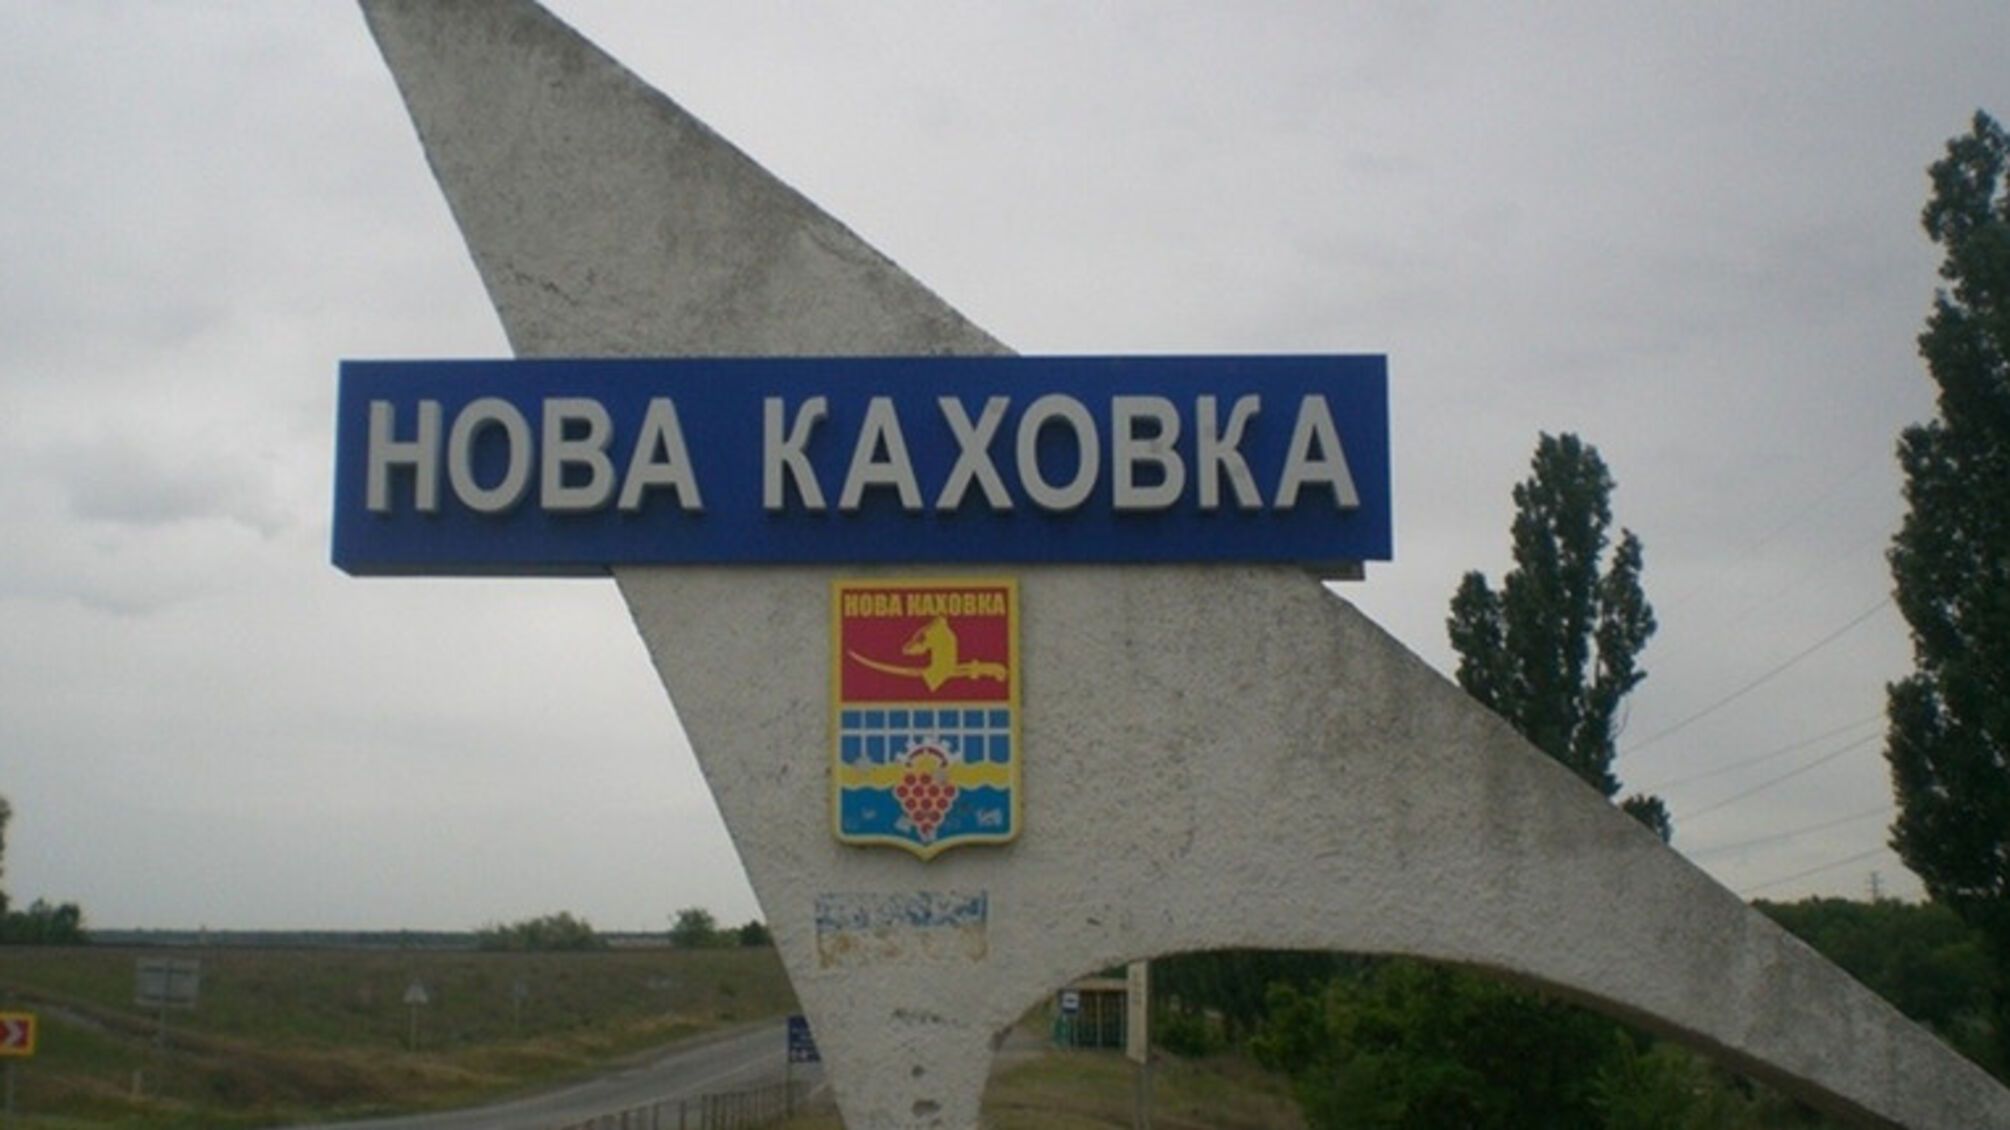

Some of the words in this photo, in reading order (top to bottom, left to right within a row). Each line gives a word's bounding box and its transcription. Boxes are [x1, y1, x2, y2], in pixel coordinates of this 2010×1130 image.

[366, 397, 702, 512] НОВА
[762, 394, 1359, 510] КАХОВКА
[844, 593, 902, 617] НОВА
[907, 592, 1005, 616] КАХОВКА
